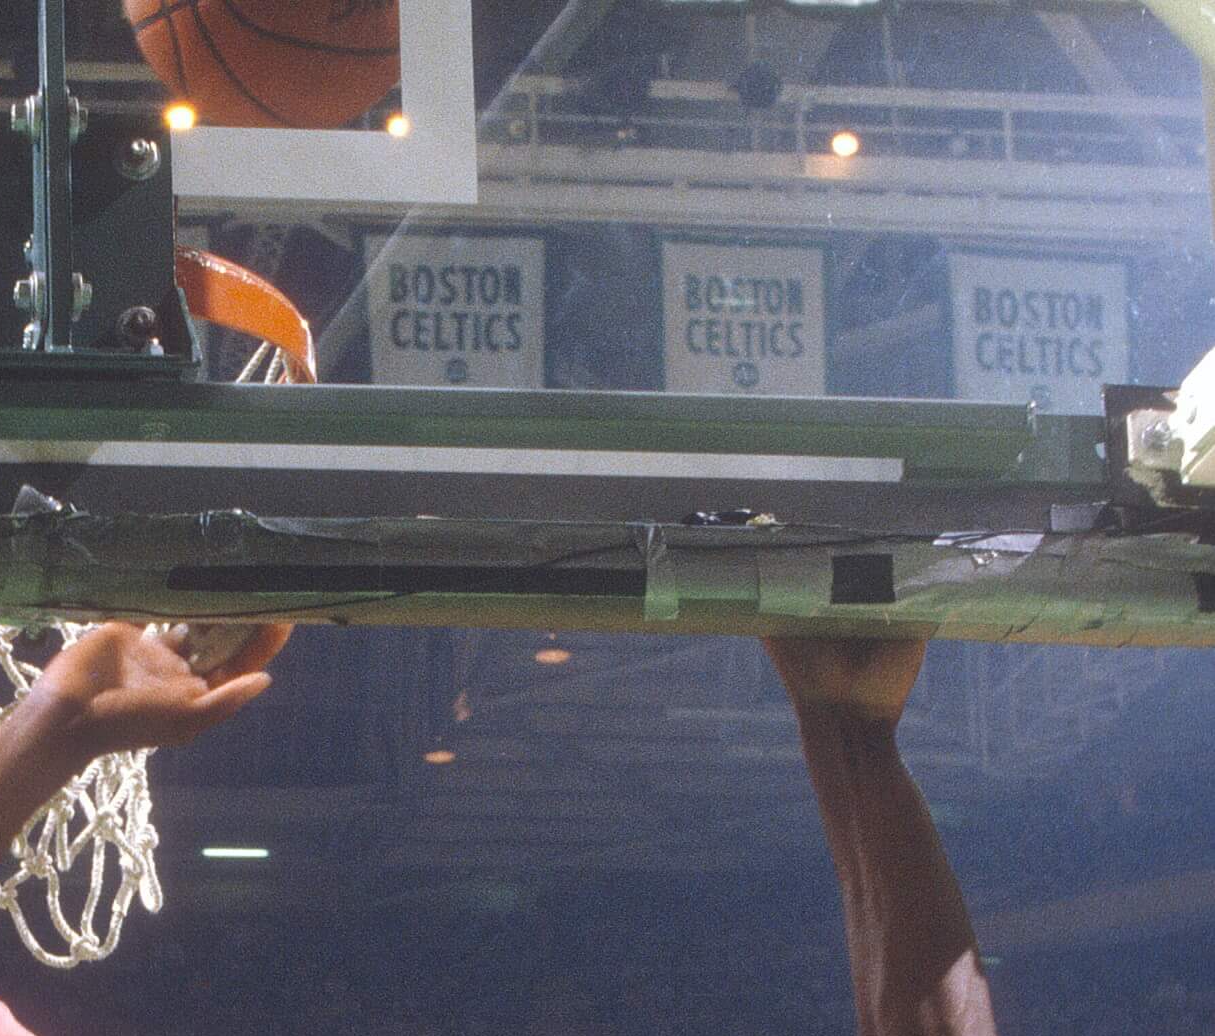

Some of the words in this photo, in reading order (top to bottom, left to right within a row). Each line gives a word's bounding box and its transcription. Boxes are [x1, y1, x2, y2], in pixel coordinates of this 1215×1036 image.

[390, 264, 521, 304] BOSTON
[687, 274, 803, 315] BOSTON
[976, 287, 1103, 329] BOSTON
[391, 309, 522, 351] CELTICS
[687, 318, 804, 357] CELTICS
[976, 332, 1103, 377] CELTICS
